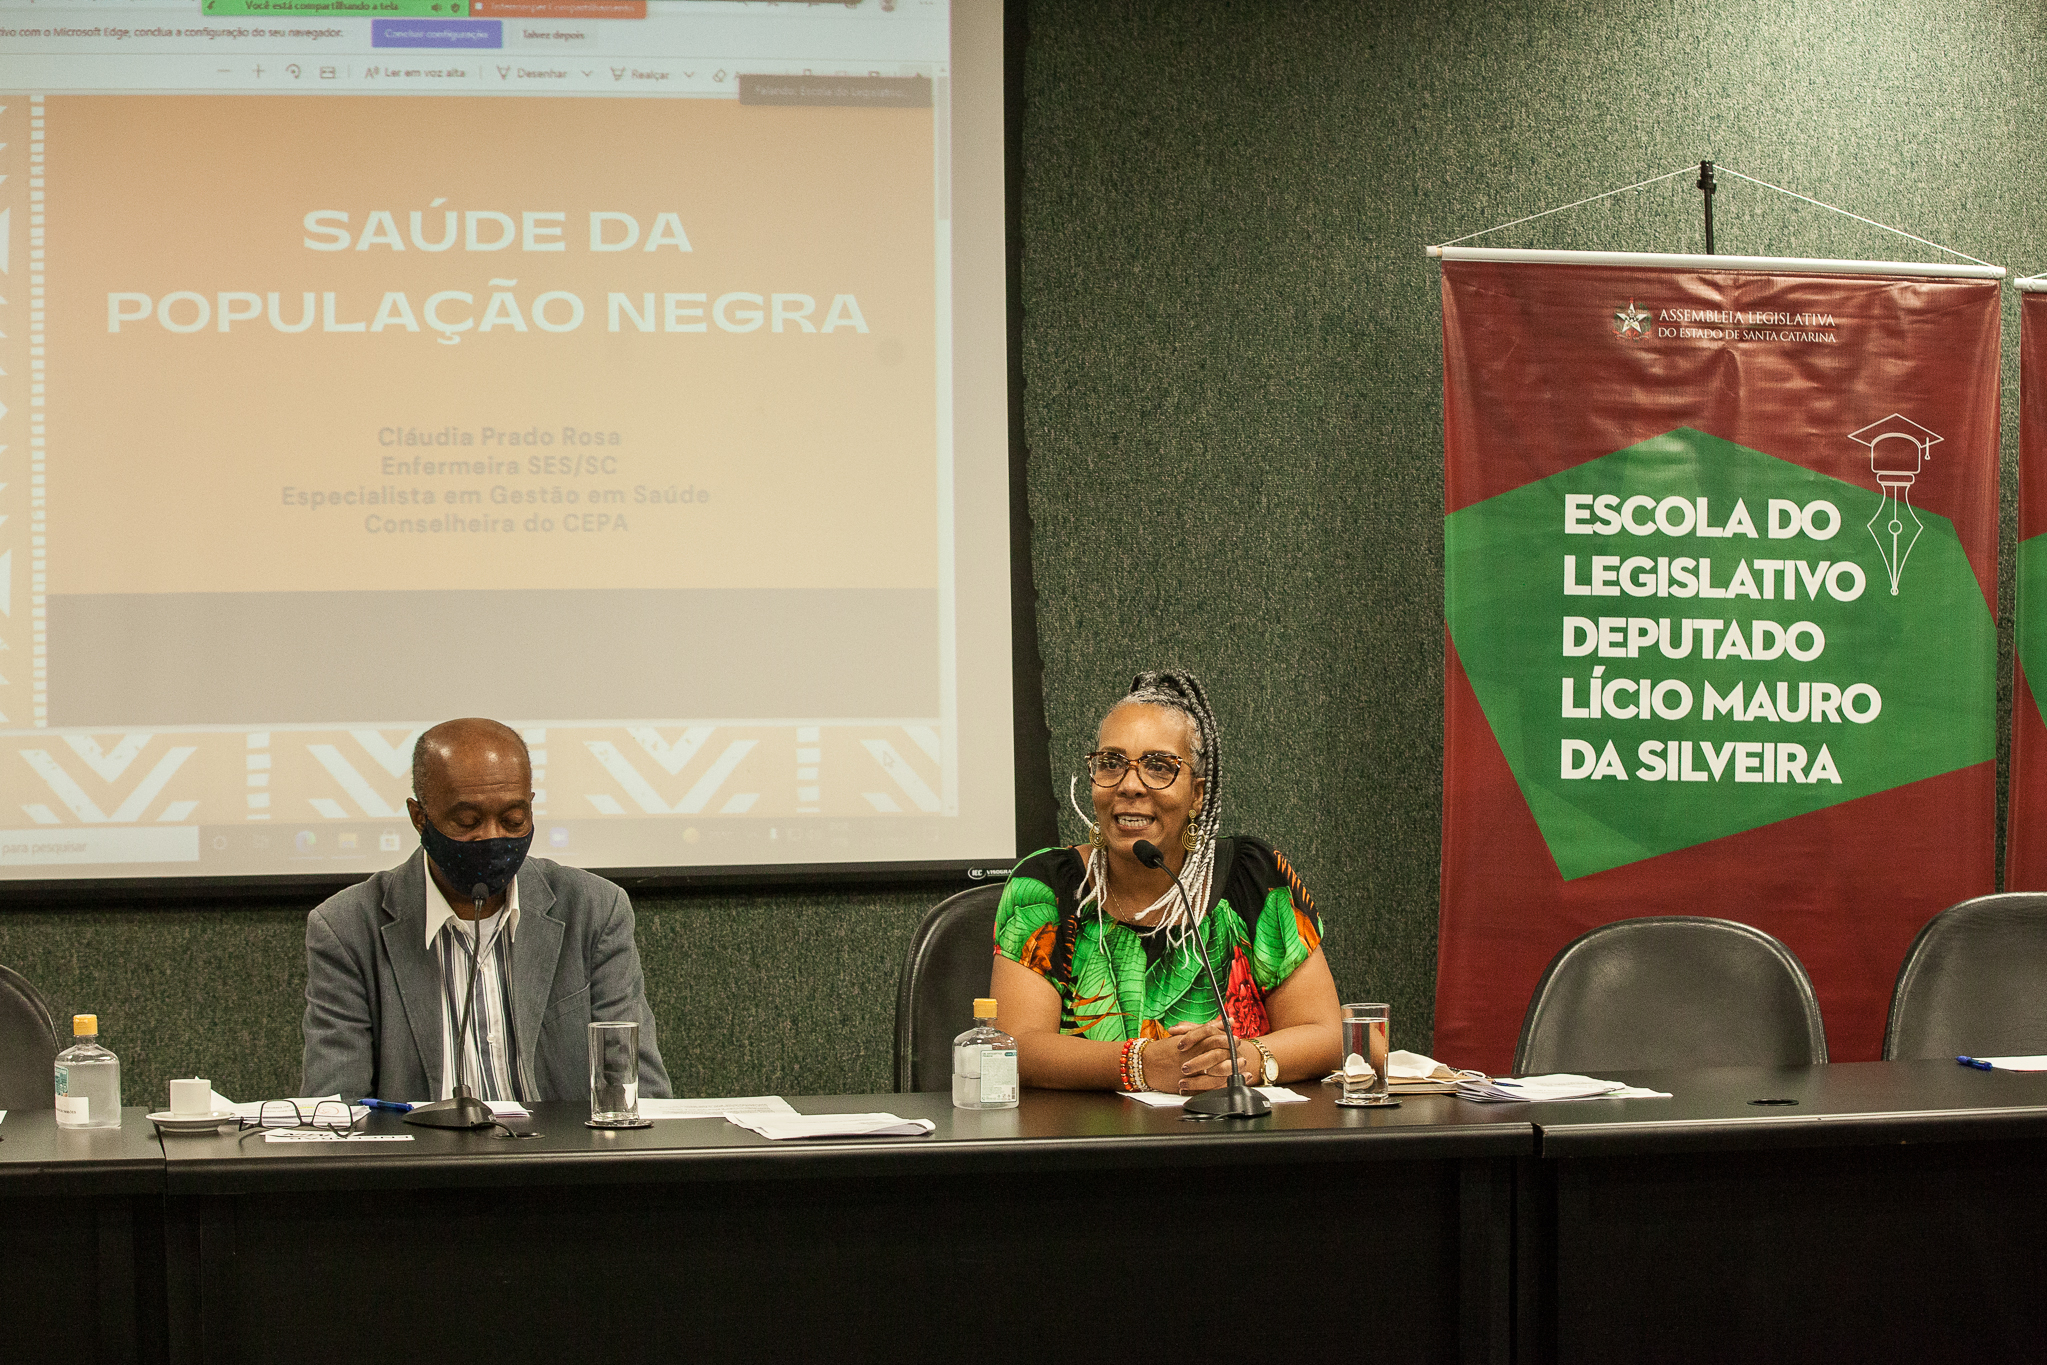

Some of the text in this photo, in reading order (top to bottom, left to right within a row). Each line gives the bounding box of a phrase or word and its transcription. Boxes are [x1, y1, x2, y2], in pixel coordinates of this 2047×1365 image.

[245, 0, 270, 10] Você
[272, 1, 293, 10] está
[294, 1, 370, 12] compartilhando
[380, 1, 399, 11] tela
[18, 29, 41, 37] com
[43, 29, 50, 37] o
[53, 27, 101, 37] Microsoft
[133, 27, 173, 37] conclua
[175, 29, 182, 37] a
[184, 27, 249, 40] configuração
[251, 28, 266, 37] do
[268, 29, 285, 37] seu
[288, 28, 343, 40] navegador.
[523, 29, 585, 42] Talvez depois
[384, 67, 466, 78] Ler em voz alta
[517, 68, 568, 78] Desenhar
[631, 69, 670, 81] Realçar
[302, 198, 693, 252] SAÚDE DA
[106, 277, 870, 346] POPULAÇÃO NEGRA
[1659, 308, 1836, 327] ASSEMBLEIA LEGISLATIVA
[1658, 327, 1837, 343] DO ESTADO DE SANTA CATARINA
[377, 427, 622, 446] Cláudia Prado Rosa
[381, 456, 618, 478] Enfermeira SES/SC
[281, 485, 710, 510] Especialista em Gestão em Saúde
[364, 513, 629, 534] Conselheira do CEPA
[1564, 493, 1842, 541] ESCOLA DO
[1563, 554, 1867, 602] LEGISLATIVO
[1562, 615, 1826, 662] DEPUTADO
[1561, 665, 1883, 724] LÍCIO MAURO
[1560, 738, 1843, 784] DA SILVEIRA
[2, 841, 88, 856] para pesquisar
